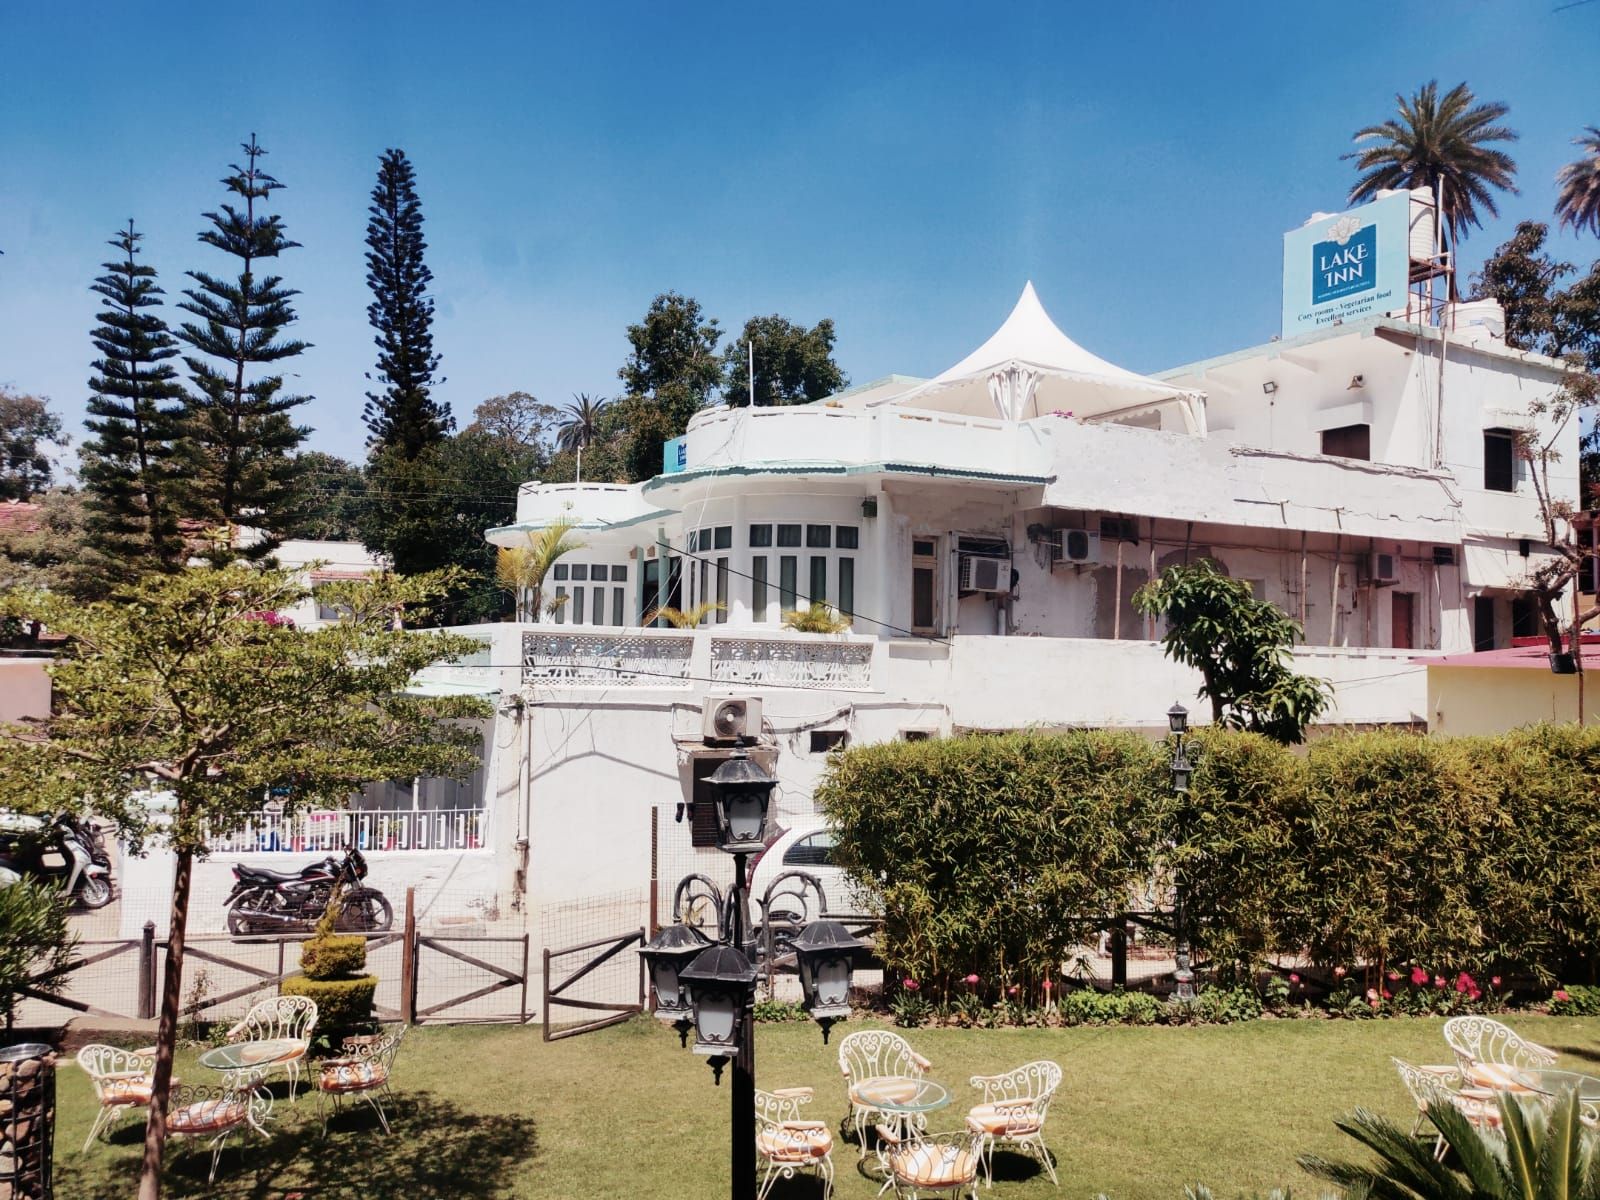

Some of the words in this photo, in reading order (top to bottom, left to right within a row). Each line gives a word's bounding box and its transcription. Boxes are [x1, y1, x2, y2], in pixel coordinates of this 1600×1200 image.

[1320, 243, 1369, 271] LAKE
[1323, 263, 1363, 288] INN
[1314, 307, 1334, 317] rooms
[1340, 295, 1375, 310] Vegetarian
[1376, 290, 1392, 300] food
[1316, 311, 1345, 325] Excellent
[1346, 305, 1372, 317] services
